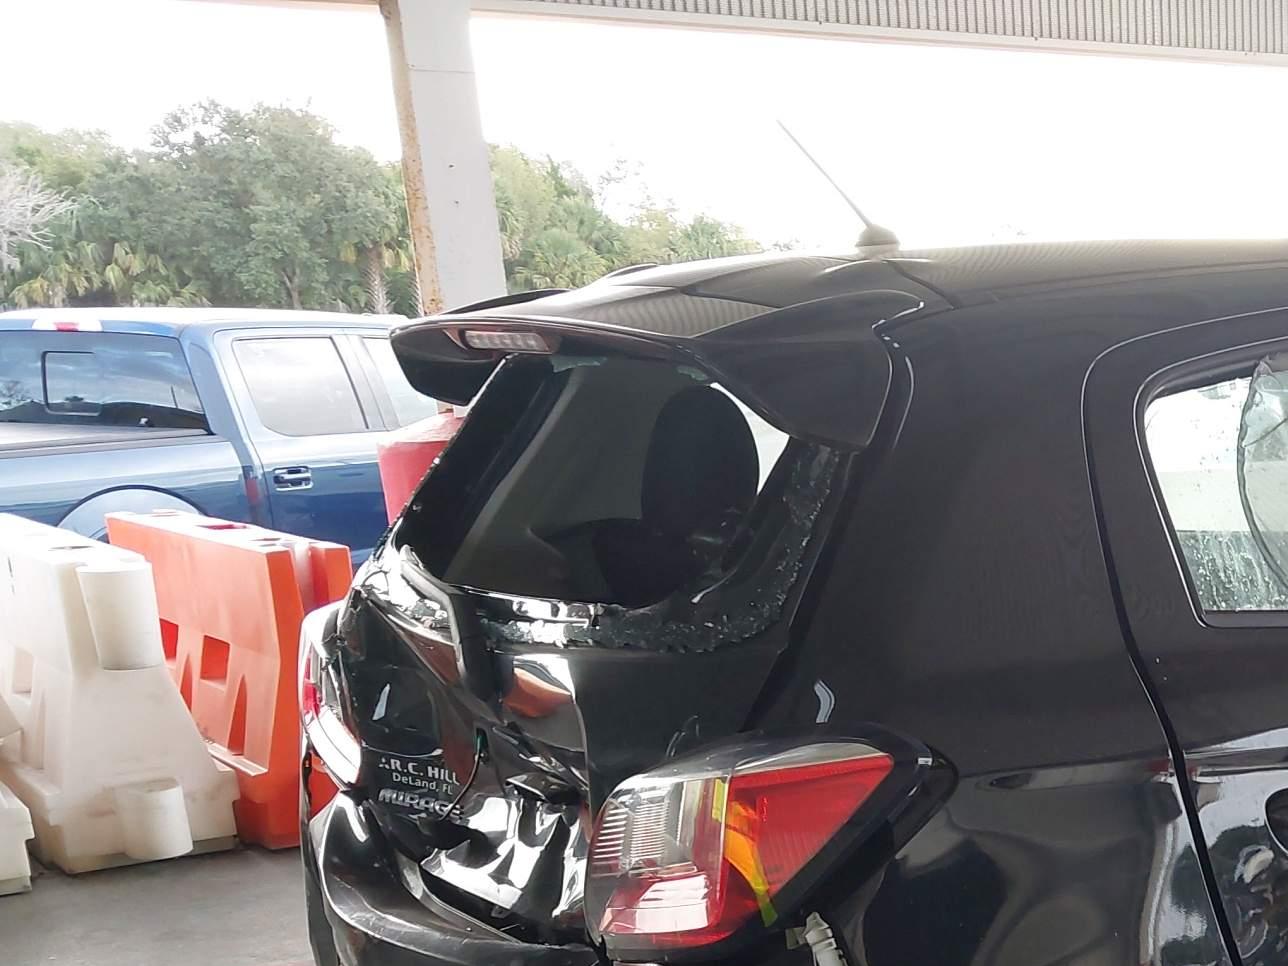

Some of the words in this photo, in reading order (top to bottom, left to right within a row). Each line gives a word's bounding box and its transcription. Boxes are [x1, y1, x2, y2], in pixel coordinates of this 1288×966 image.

[390, 758, 424, 776] R.C.
[427, 765, 460, 786] HILL
[392, 772, 440, 793] DeLand,
[442, 783, 454, 796] FL
[378, 788, 464, 820] MIRAGE
